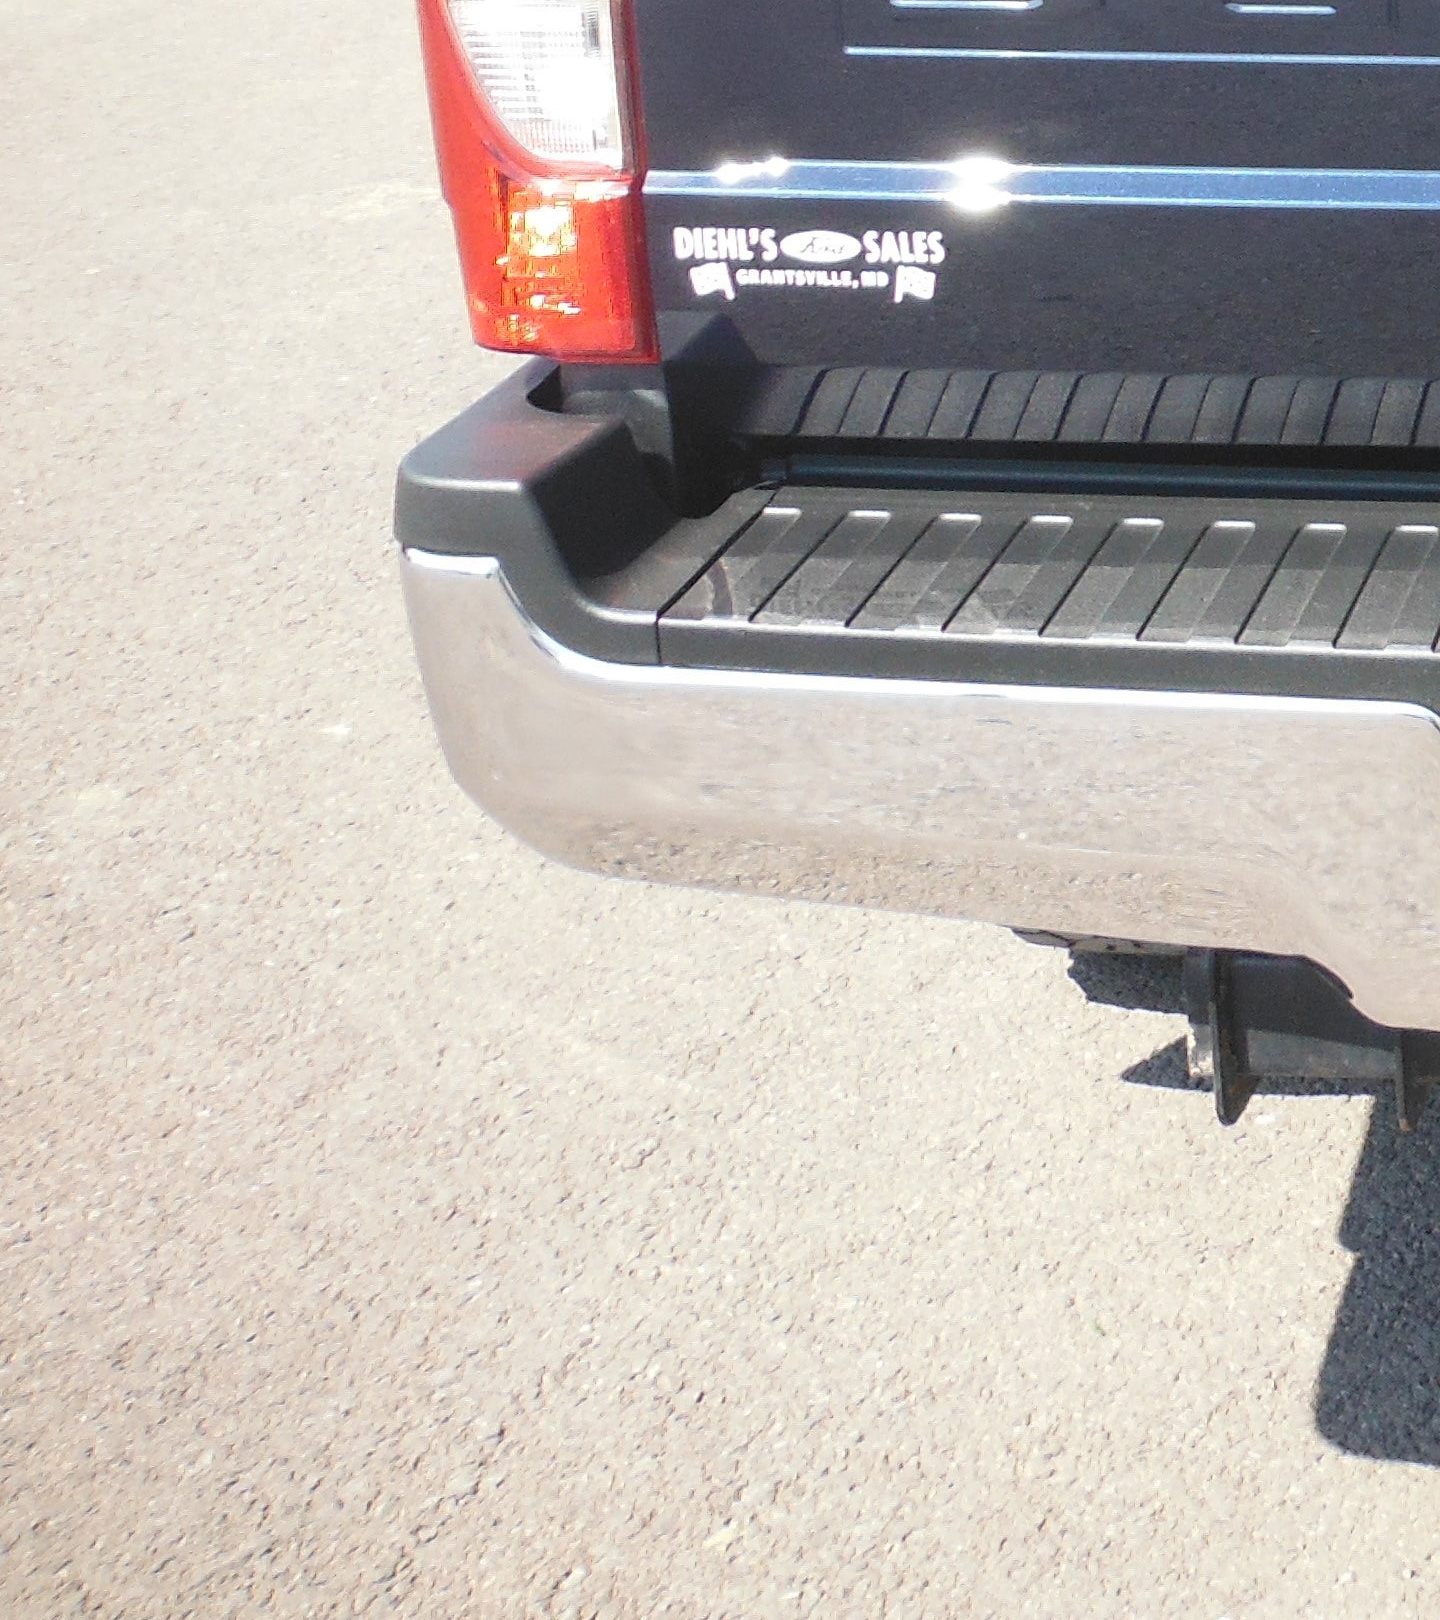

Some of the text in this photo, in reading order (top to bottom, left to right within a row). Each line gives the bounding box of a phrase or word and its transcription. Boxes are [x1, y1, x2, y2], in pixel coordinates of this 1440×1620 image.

[673, 226, 779, 262] DIEHL'S
[862, 229, 946, 265] SALES
[735, 267, 859, 289] GRANTSVILLE,
